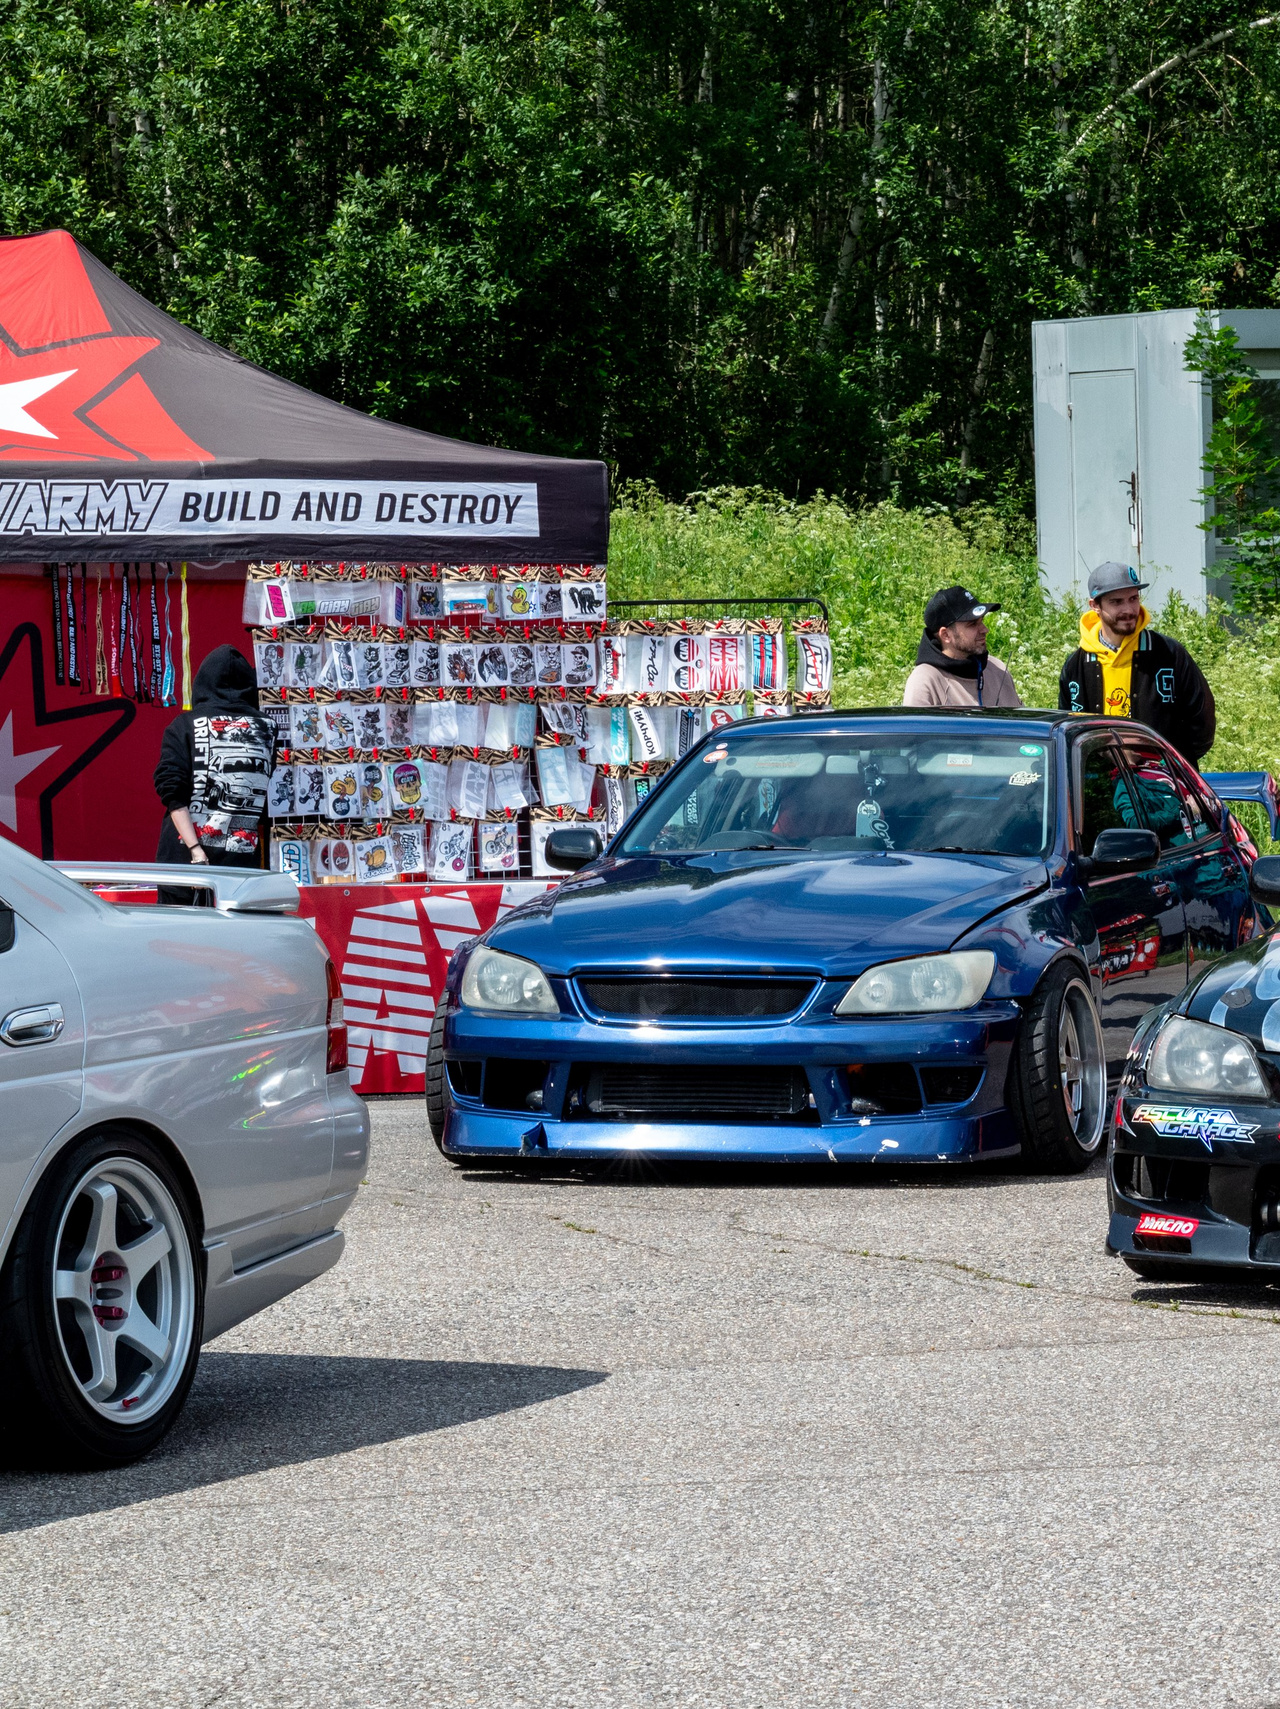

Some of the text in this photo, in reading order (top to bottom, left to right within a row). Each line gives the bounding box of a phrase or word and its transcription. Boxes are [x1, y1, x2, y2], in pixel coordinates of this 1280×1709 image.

[179, 490, 281, 523] BUILD
[291, 491, 362, 523] AND
[375, 492, 523, 525] DESTROY
[66, 593, 74, 618] DESTROY
[151, 613, 160, 640] POLICE!
[604, 648, 614, 685] BANNED
[193, 716, 209, 765] DRIFT
[633, 710, 656, 756] КОРЧУЙ!
[189, 769, 209, 813] KING
[1133, 1106, 1223, 1124] ASCURA
[1162, 1121, 1255, 1140] GARAGE
